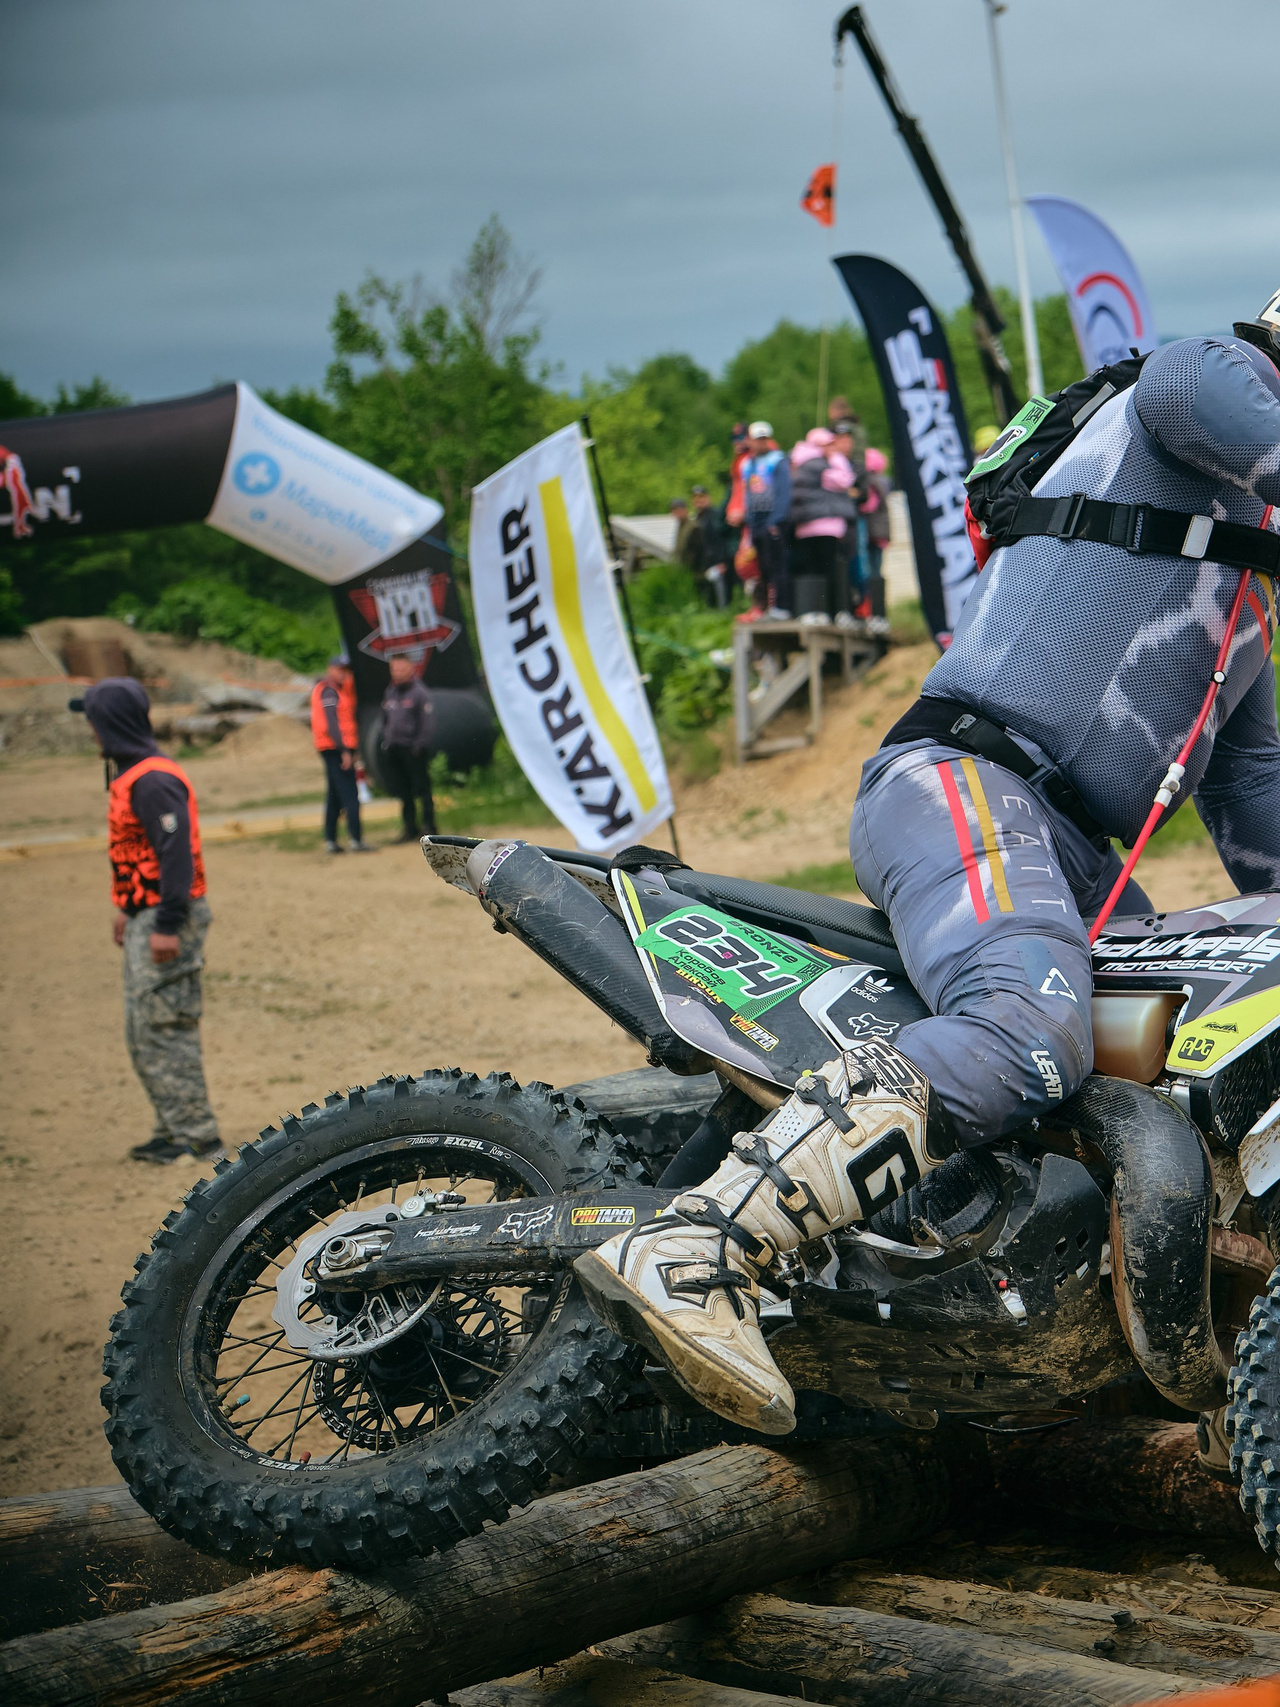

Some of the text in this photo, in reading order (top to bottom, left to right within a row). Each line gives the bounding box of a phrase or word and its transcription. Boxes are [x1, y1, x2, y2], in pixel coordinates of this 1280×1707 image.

[501, 503, 632, 839] KÄRCHER
[989, 761, 1067, 914] EATT
[656, 914, 802, 998] 234
[727, 920, 798, 964] BRONZE
[668, 955, 718, 988] Алексей
[675, 949, 726, 985] Коробов
[1099, 959, 1267, 974] MOTORSPORT
[850, 986, 879, 1003] adidas
[1180, 1037, 1213, 1057] PPG
[1030, 1050, 1063, 1100] LEATT
[443, 1136, 484, 1151] EXCEL
[573, 1207, 634, 1225] PROTAPER
[551, 1273, 573, 1322] GRIP
[257, 1457, 300, 1470] EXCEL
